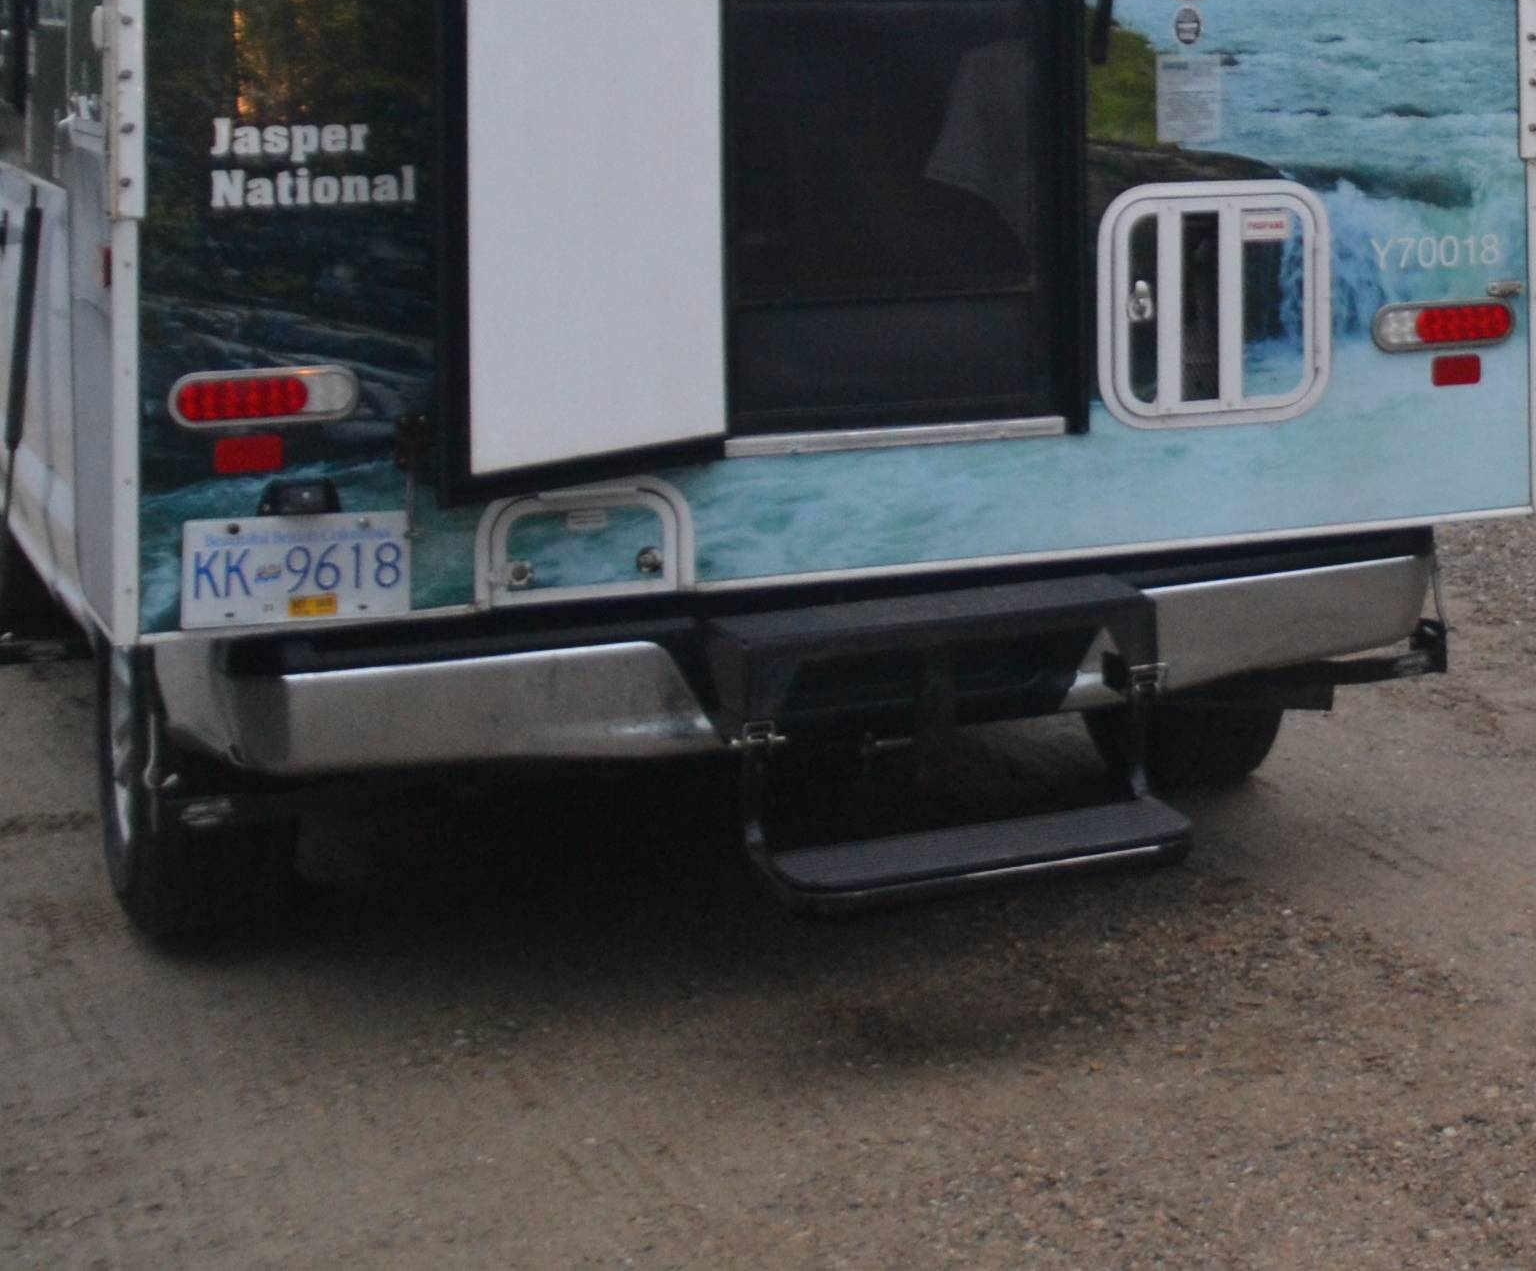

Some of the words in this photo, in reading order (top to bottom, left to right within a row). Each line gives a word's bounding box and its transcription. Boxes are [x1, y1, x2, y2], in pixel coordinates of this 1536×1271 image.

[210, 116, 370, 164] Jasper
[210, 165, 417, 208] National
[1370, 232, 1501, 270] Y70018
[193, 548, 252, 600] KK
[285, 541, 402, 594] 9618
